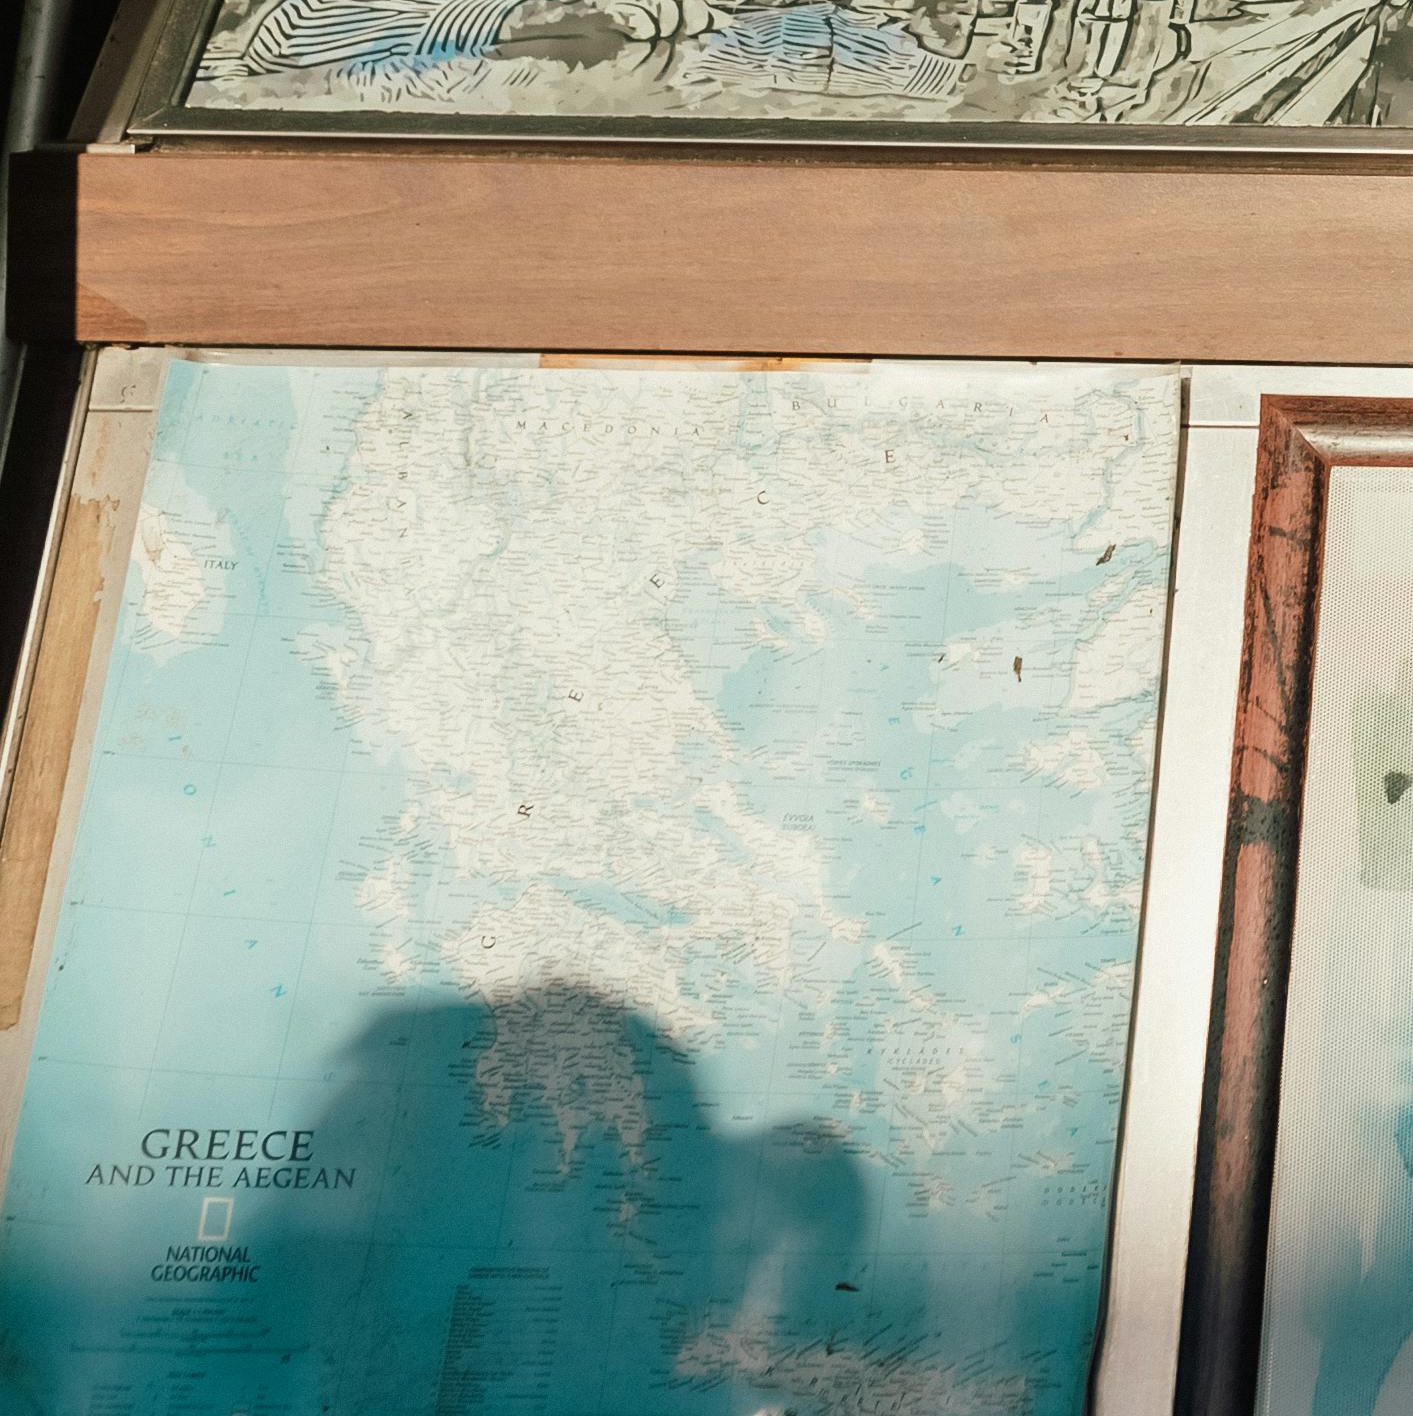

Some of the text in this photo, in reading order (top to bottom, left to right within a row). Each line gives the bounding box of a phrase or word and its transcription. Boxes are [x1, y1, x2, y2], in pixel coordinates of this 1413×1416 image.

[516, 420, 701, 436] MACEDONIA
[203, 559, 238, 571] ITALY
[141, 1129, 314, 1161] GREECE
[84, 1163, 357, 1189] AND THE AEGEAN
[165, 1245, 251, 1264] NATIONAL
[151, 1264, 260, 1284] GEOGRAPHIC
